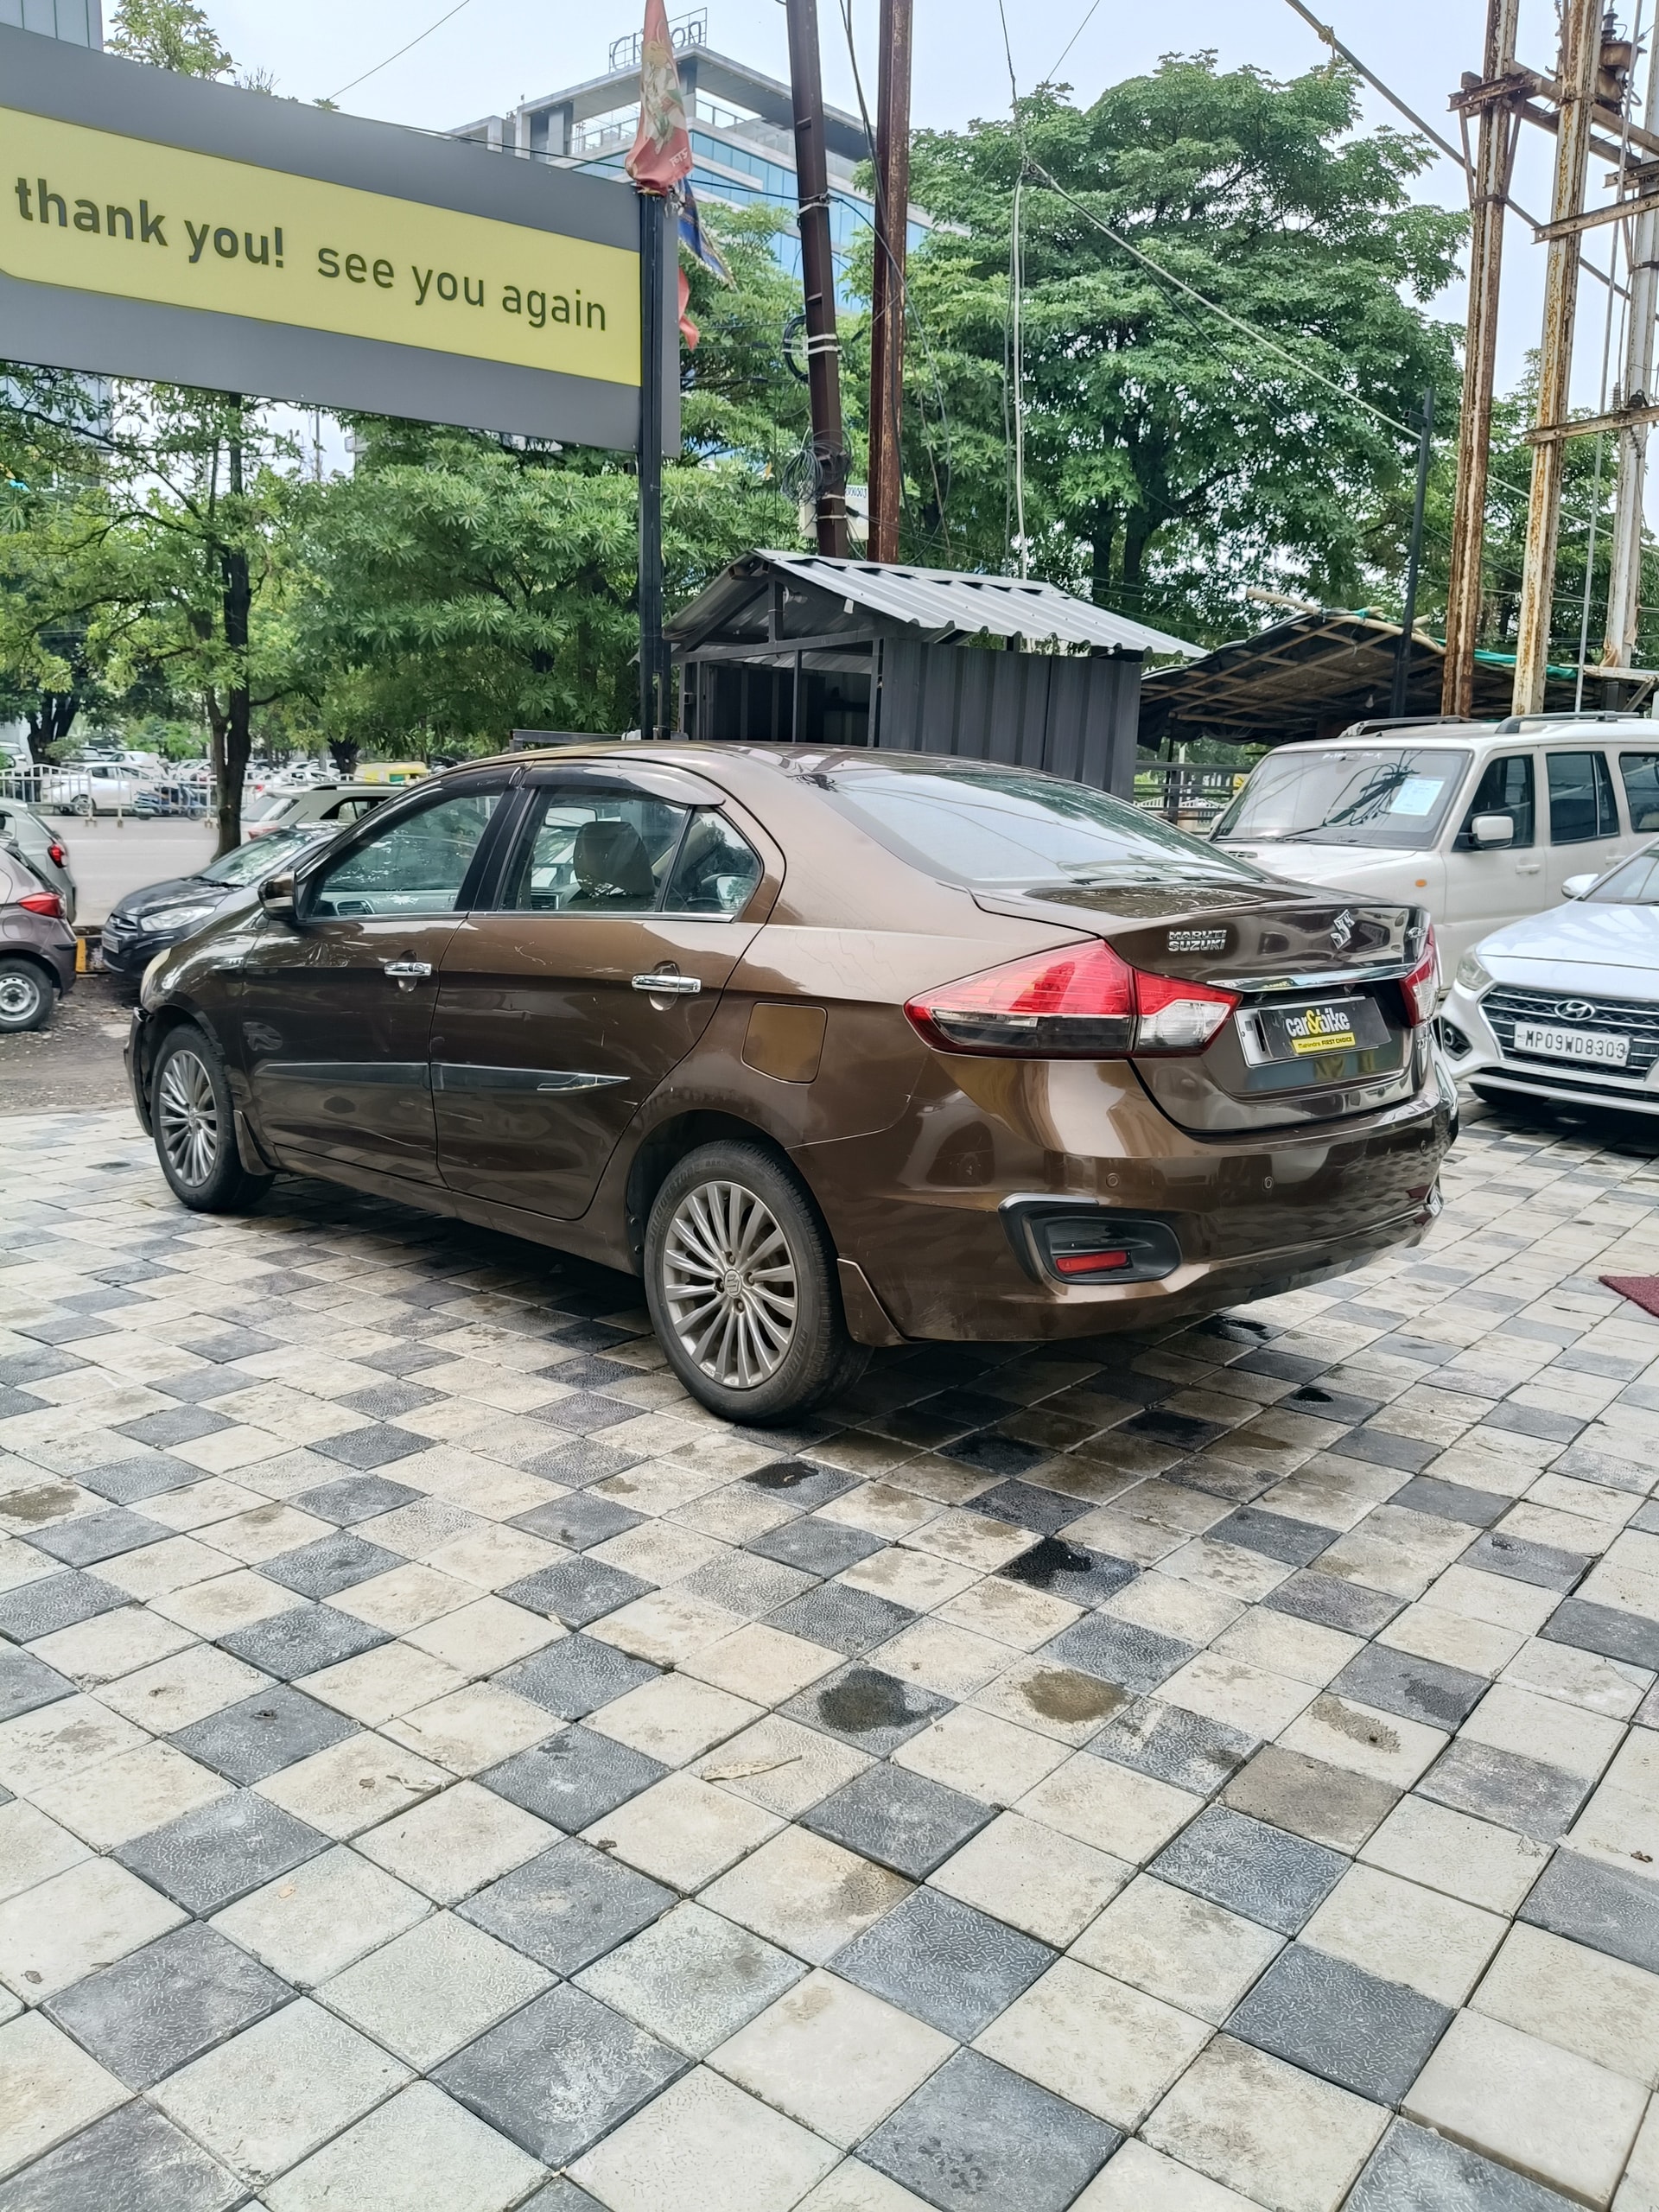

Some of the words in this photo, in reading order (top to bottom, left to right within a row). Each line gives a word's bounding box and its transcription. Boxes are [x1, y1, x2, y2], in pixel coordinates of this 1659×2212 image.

[15, 178, 168, 247] thank
[183, 219, 284, 269] you!
[317, 247, 395, 289] see
[411, 265, 485, 308] you
[502, 286, 606, 331] again
[1168, 930, 1227, 940] MARUTI
[1167, 939, 1226, 951] SUZUKI
